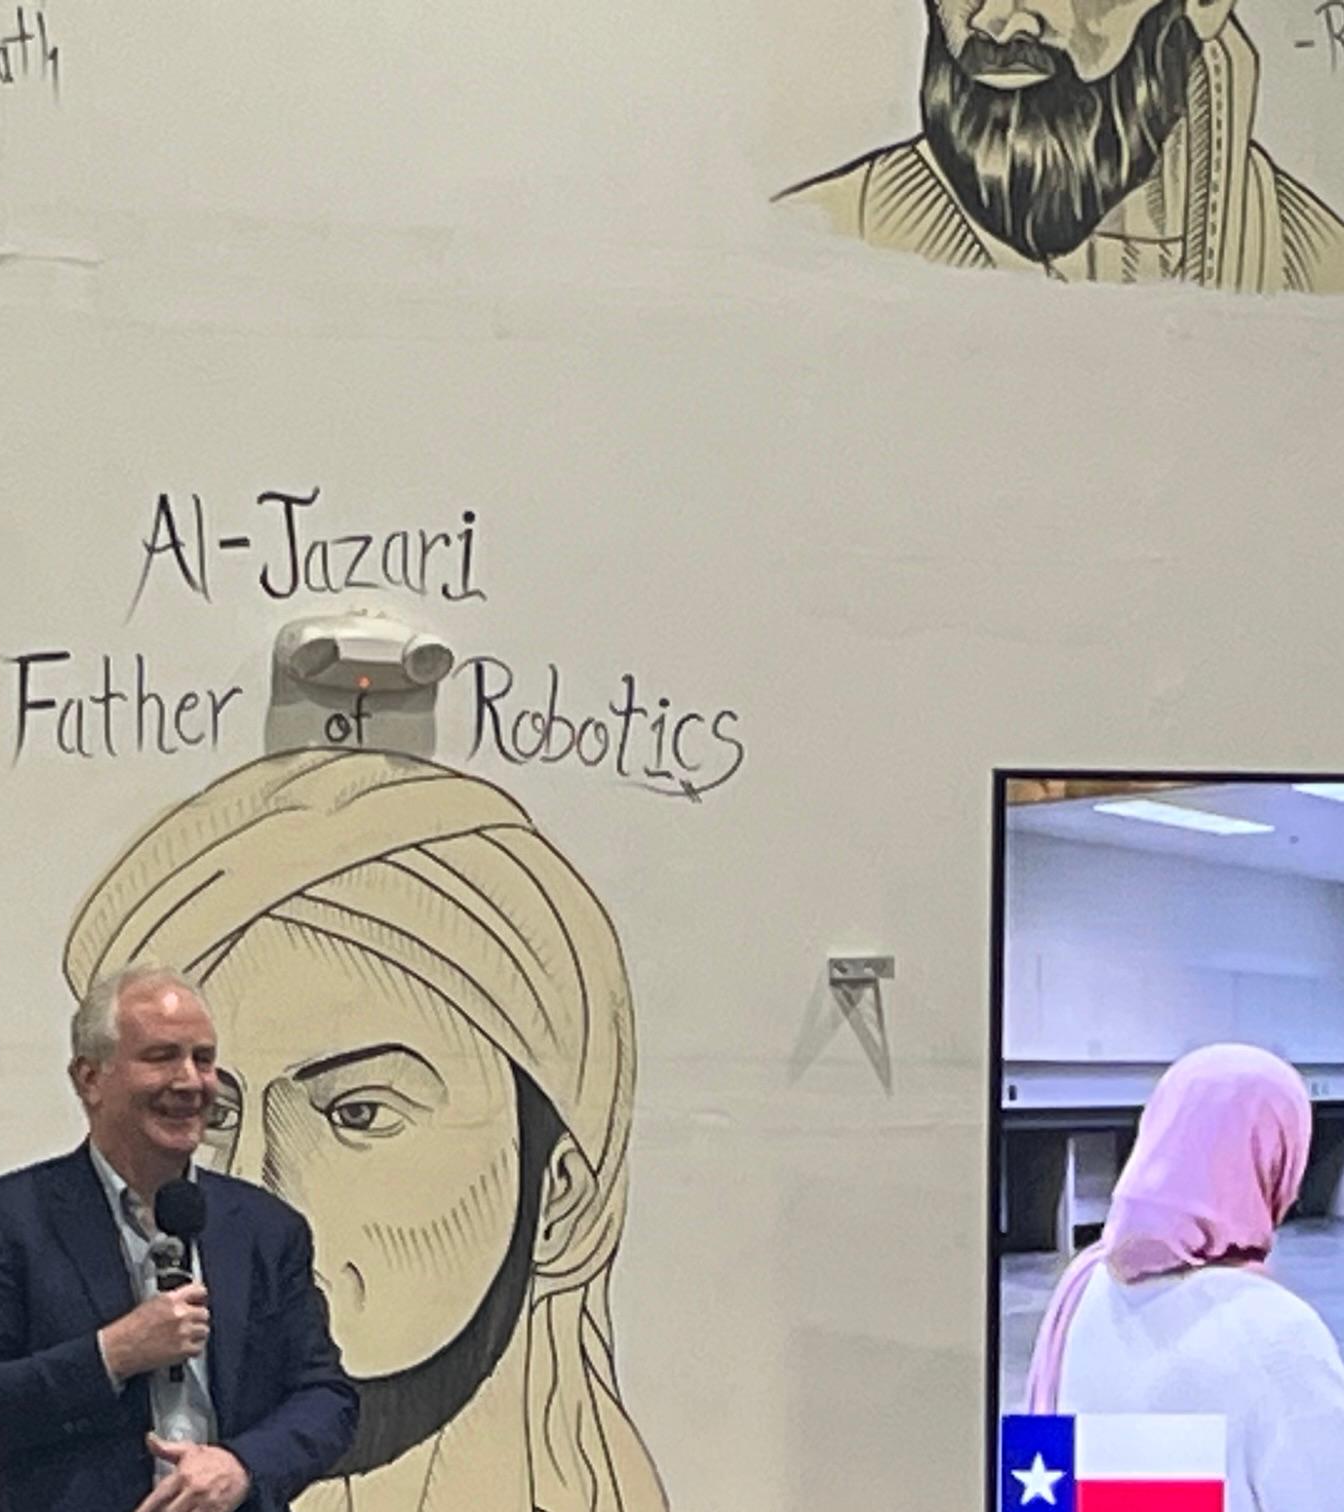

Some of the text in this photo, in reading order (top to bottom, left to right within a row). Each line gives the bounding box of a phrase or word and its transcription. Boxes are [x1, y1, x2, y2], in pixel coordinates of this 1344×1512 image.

[123, 486, 488, 624] Al-Jazari
[0, 651, 746, 803] Father of Robotics
